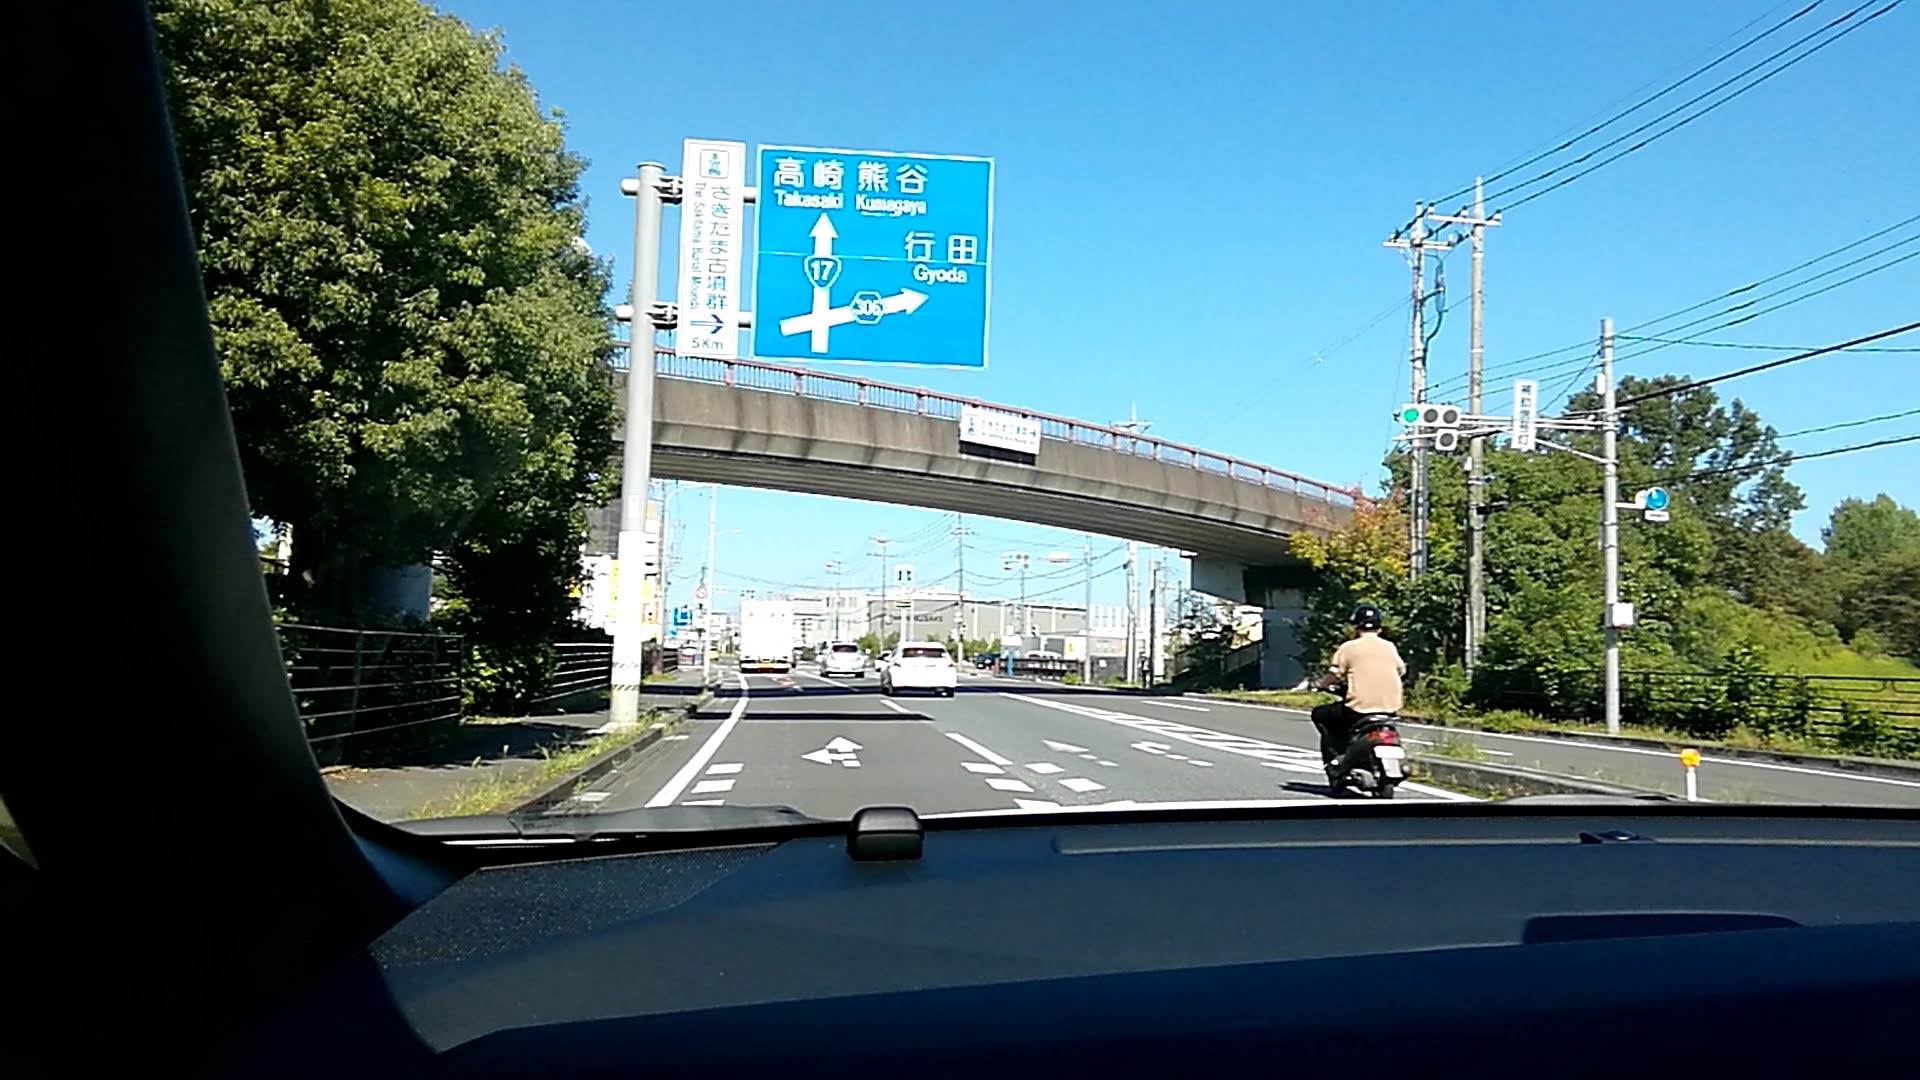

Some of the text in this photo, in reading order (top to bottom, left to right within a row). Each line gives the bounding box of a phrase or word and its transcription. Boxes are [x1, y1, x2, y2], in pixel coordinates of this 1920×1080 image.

[773, 156, 929, 194] 高崎 熊谷
[774, 189, 927, 217] Takasaki Kumagaya
[705, 184, 731, 310] さきたま古墳群
[904, 230, 978, 264] 行田
[810, 260, 833, 282] 17
[912, 263, 968, 286] Gyoda
